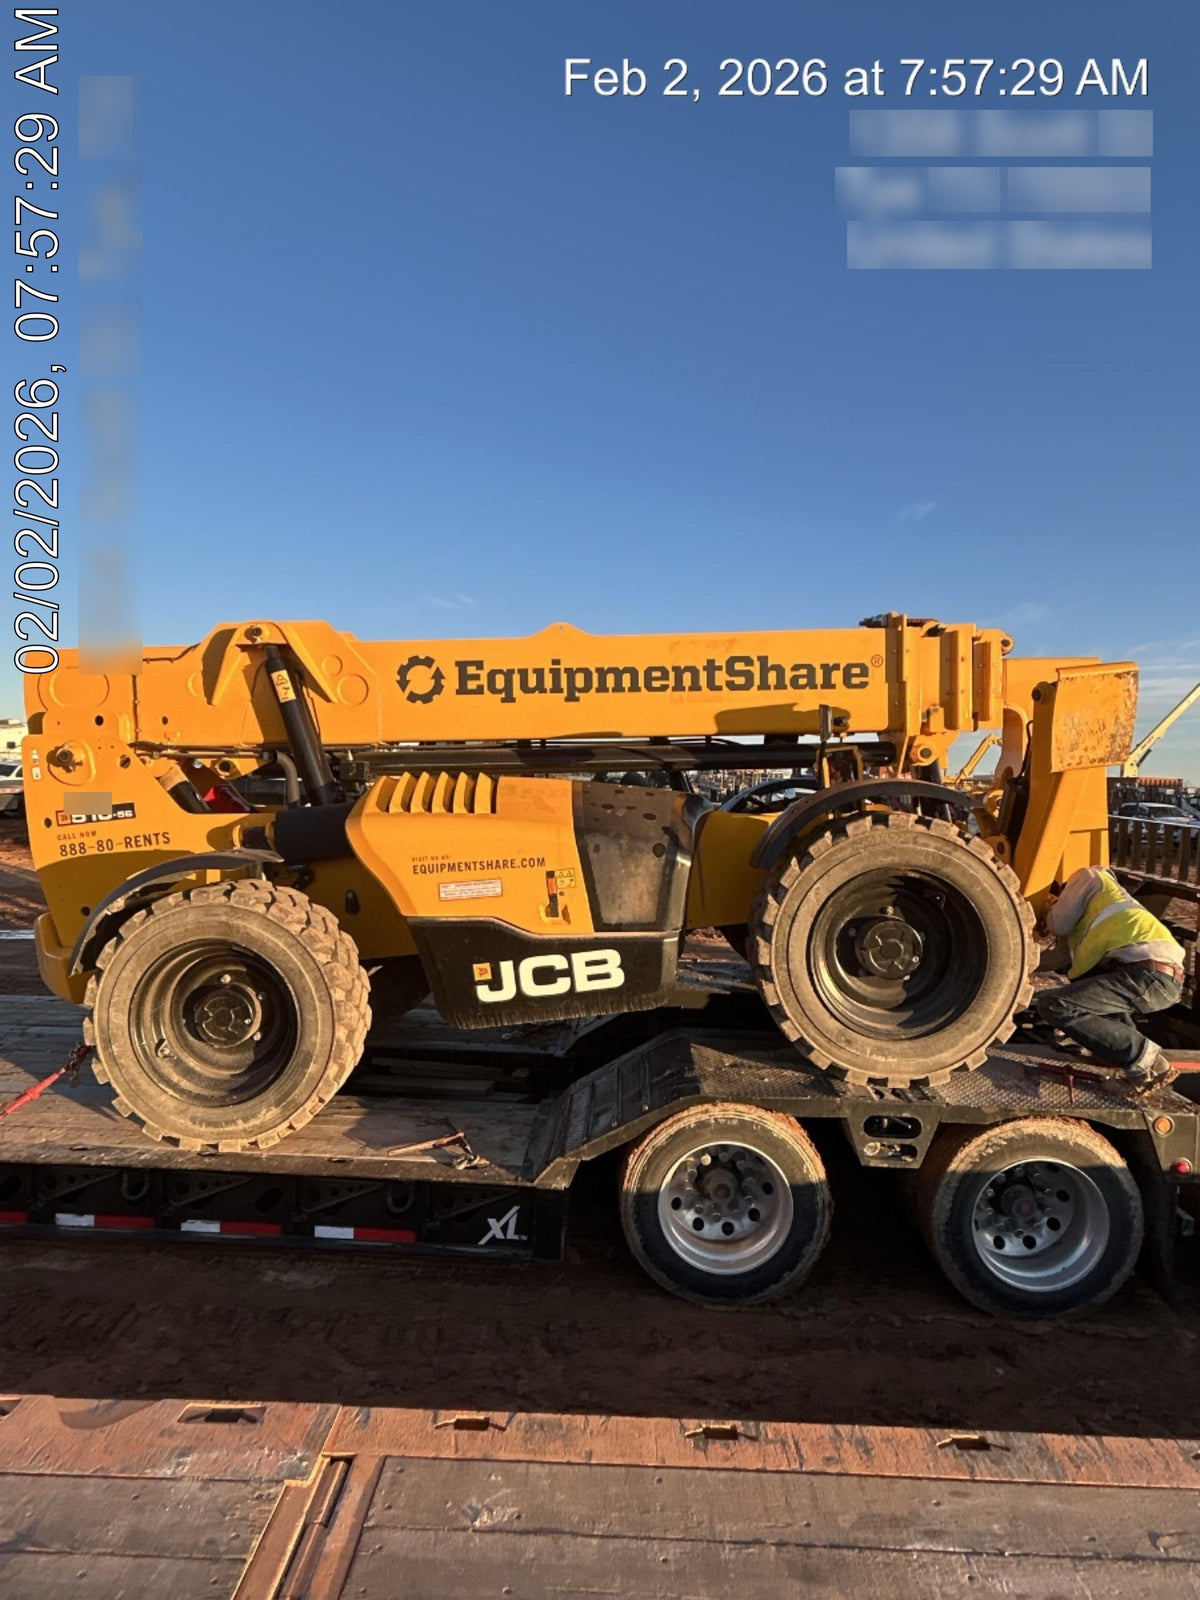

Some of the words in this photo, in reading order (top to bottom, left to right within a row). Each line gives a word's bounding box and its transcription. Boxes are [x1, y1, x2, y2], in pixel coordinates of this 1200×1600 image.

[57, 833, 76, 841] CALL
[80, 830, 97, 838] NOW
[59, 831, 171, 857] 888-80-RENTS
[412, 857, 546, 875] EQUIPMENTSHARE.COM
[473, 949, 625, 1003] JCB
[478, 1205, 528, 1245] XL
